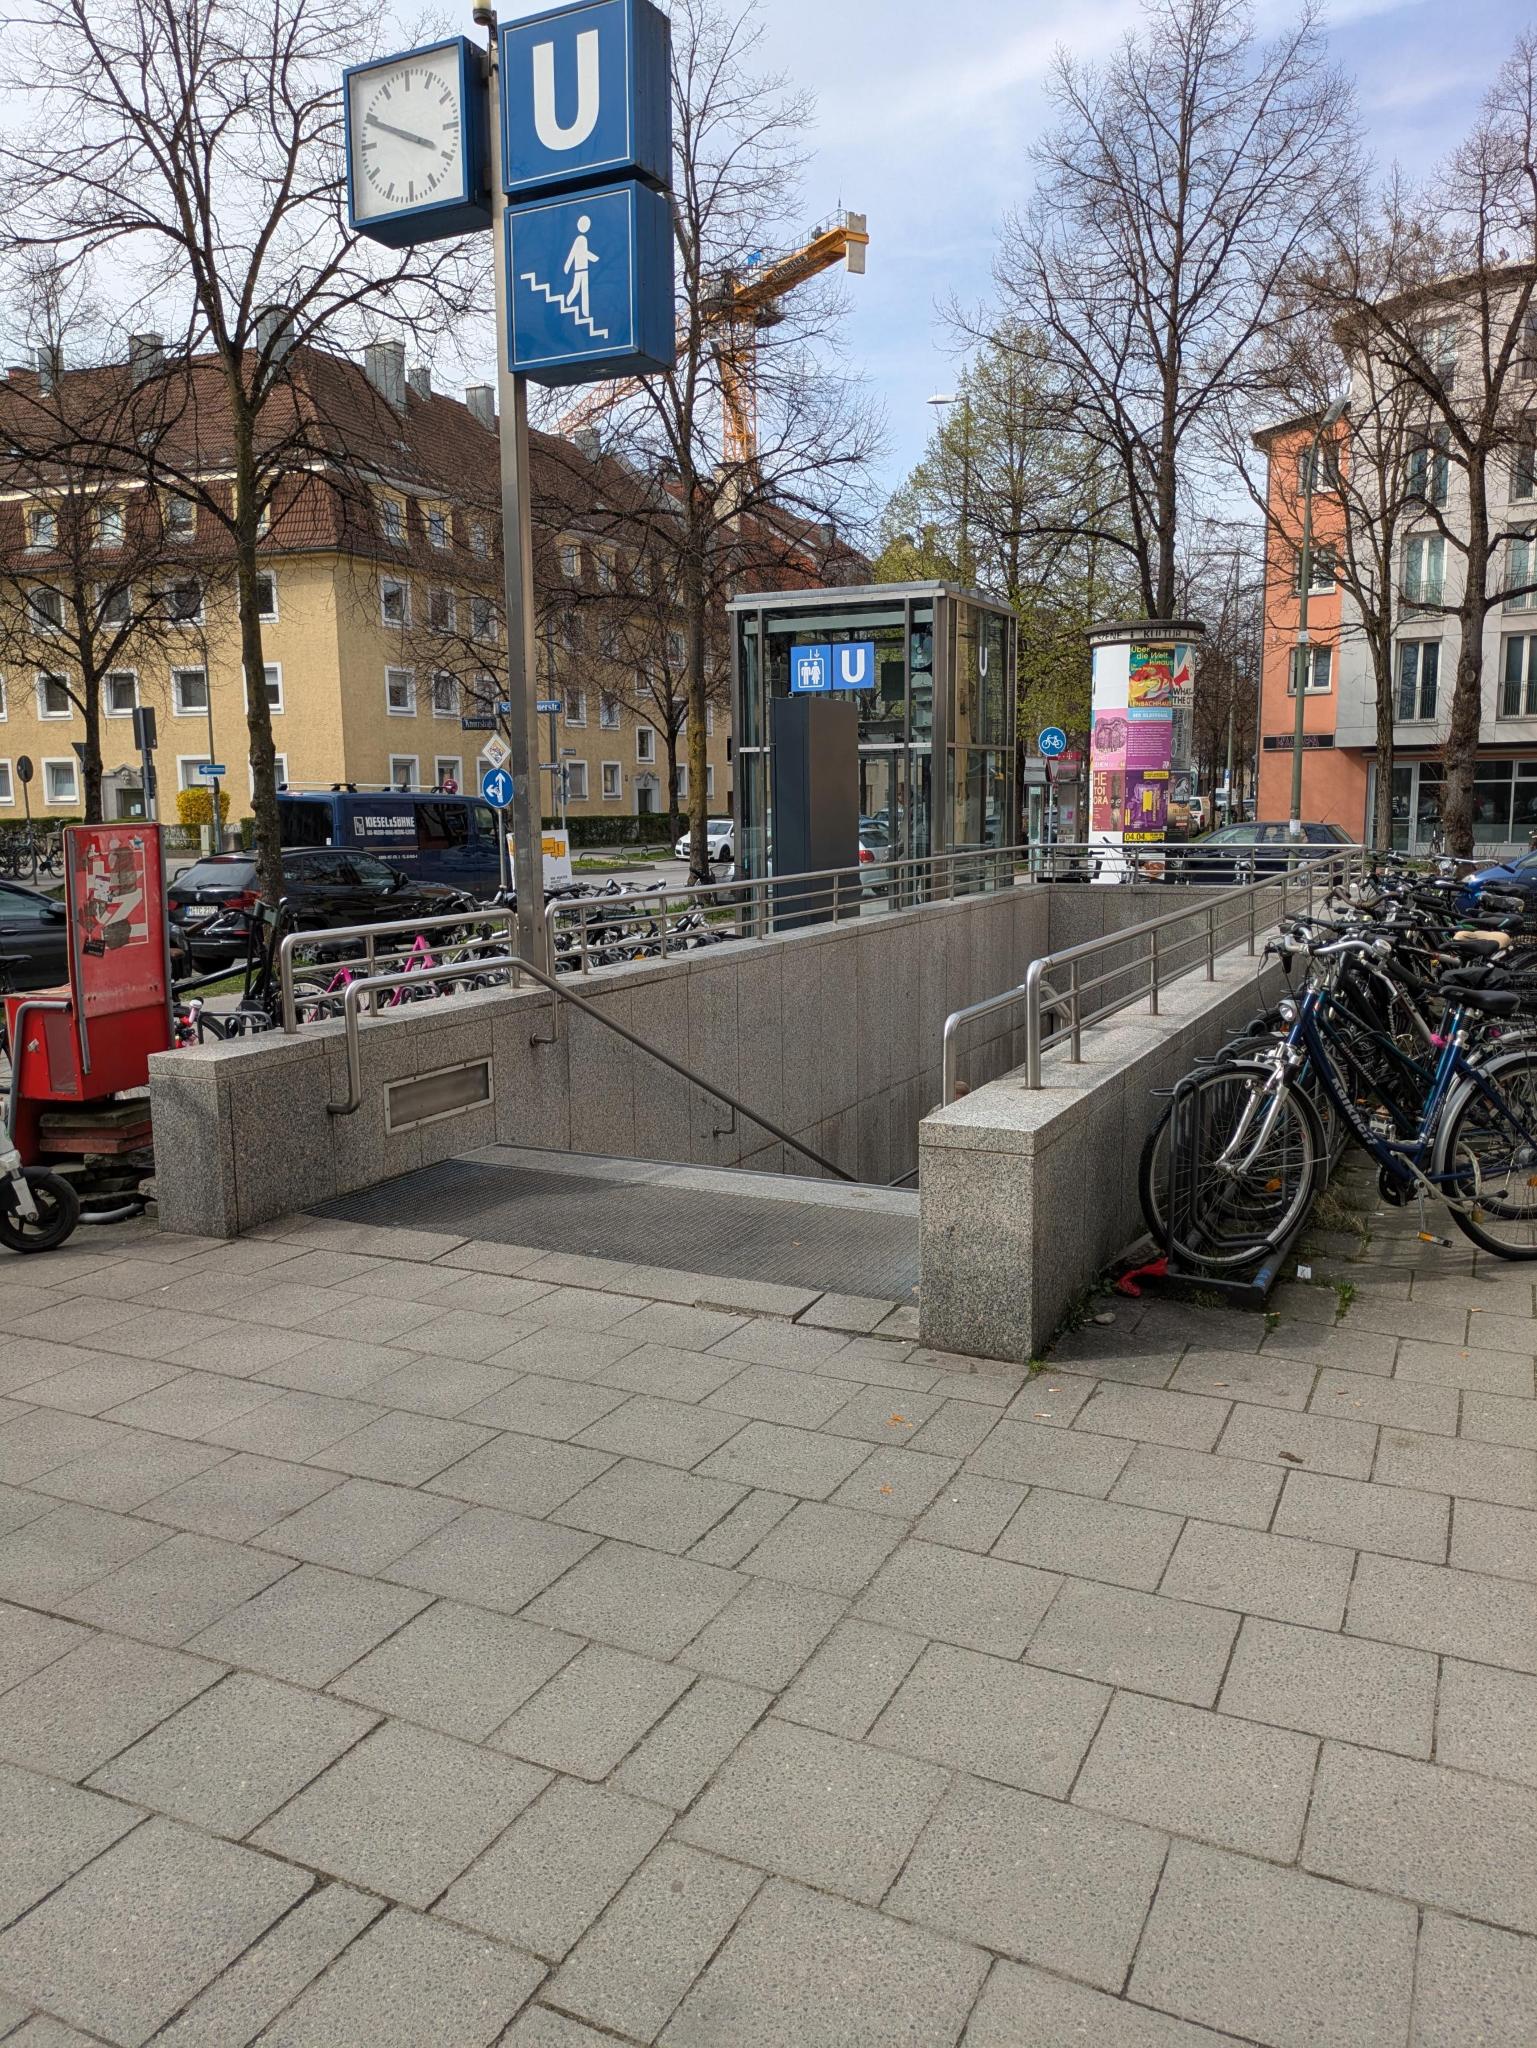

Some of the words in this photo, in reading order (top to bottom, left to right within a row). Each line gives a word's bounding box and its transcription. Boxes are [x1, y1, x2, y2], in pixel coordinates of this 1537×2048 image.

[533, 29, 599, 150] U
[979, 646, 988, 677] U
[1137, 651, 1148, 659] die
[841, 649, 865, 683] U
[1093, 772, 1107, 785] HE
[1094, 787, 1105, 795] TOI
[1093, 796, 1108, 805] ORA
